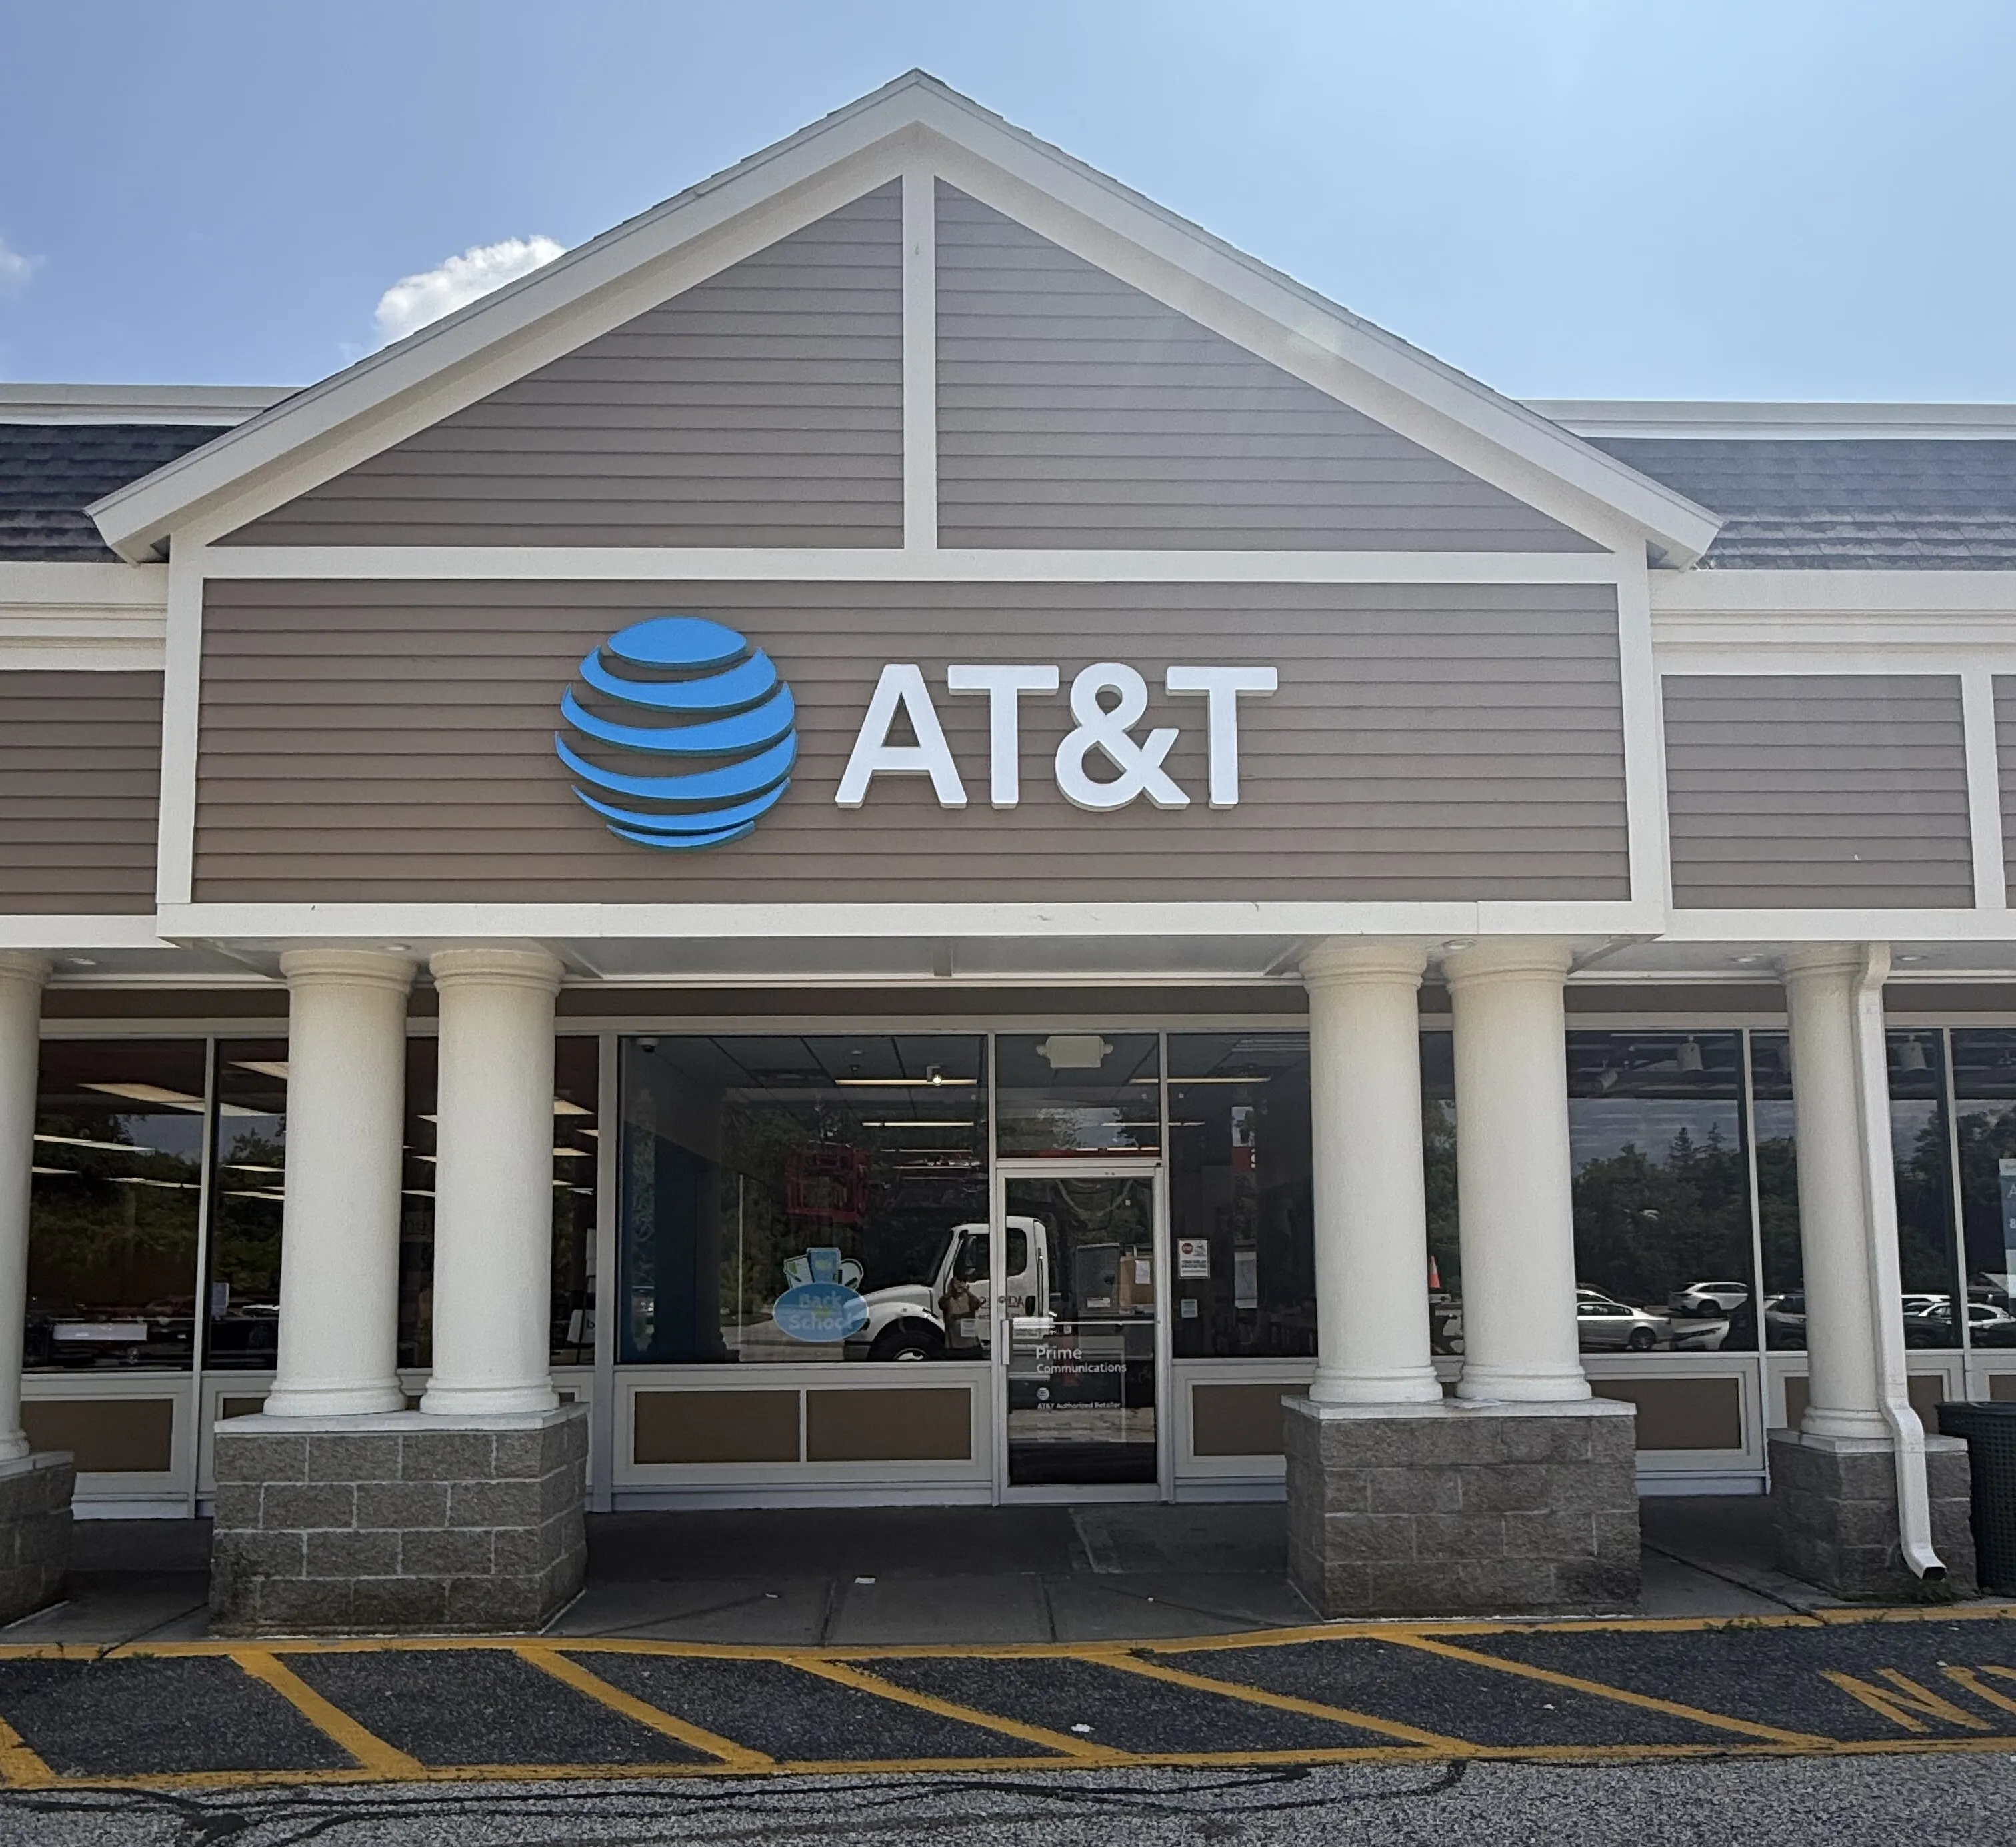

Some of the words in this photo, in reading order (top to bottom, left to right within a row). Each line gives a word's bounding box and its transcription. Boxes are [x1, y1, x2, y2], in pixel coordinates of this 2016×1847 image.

[835, 662, 1278, 811] AT&T
[799, 1290, 842, 1308] Back
[1036, 1345, 1083, 1360] Prime
[1036, 1362, 1127, 1374] Communications
